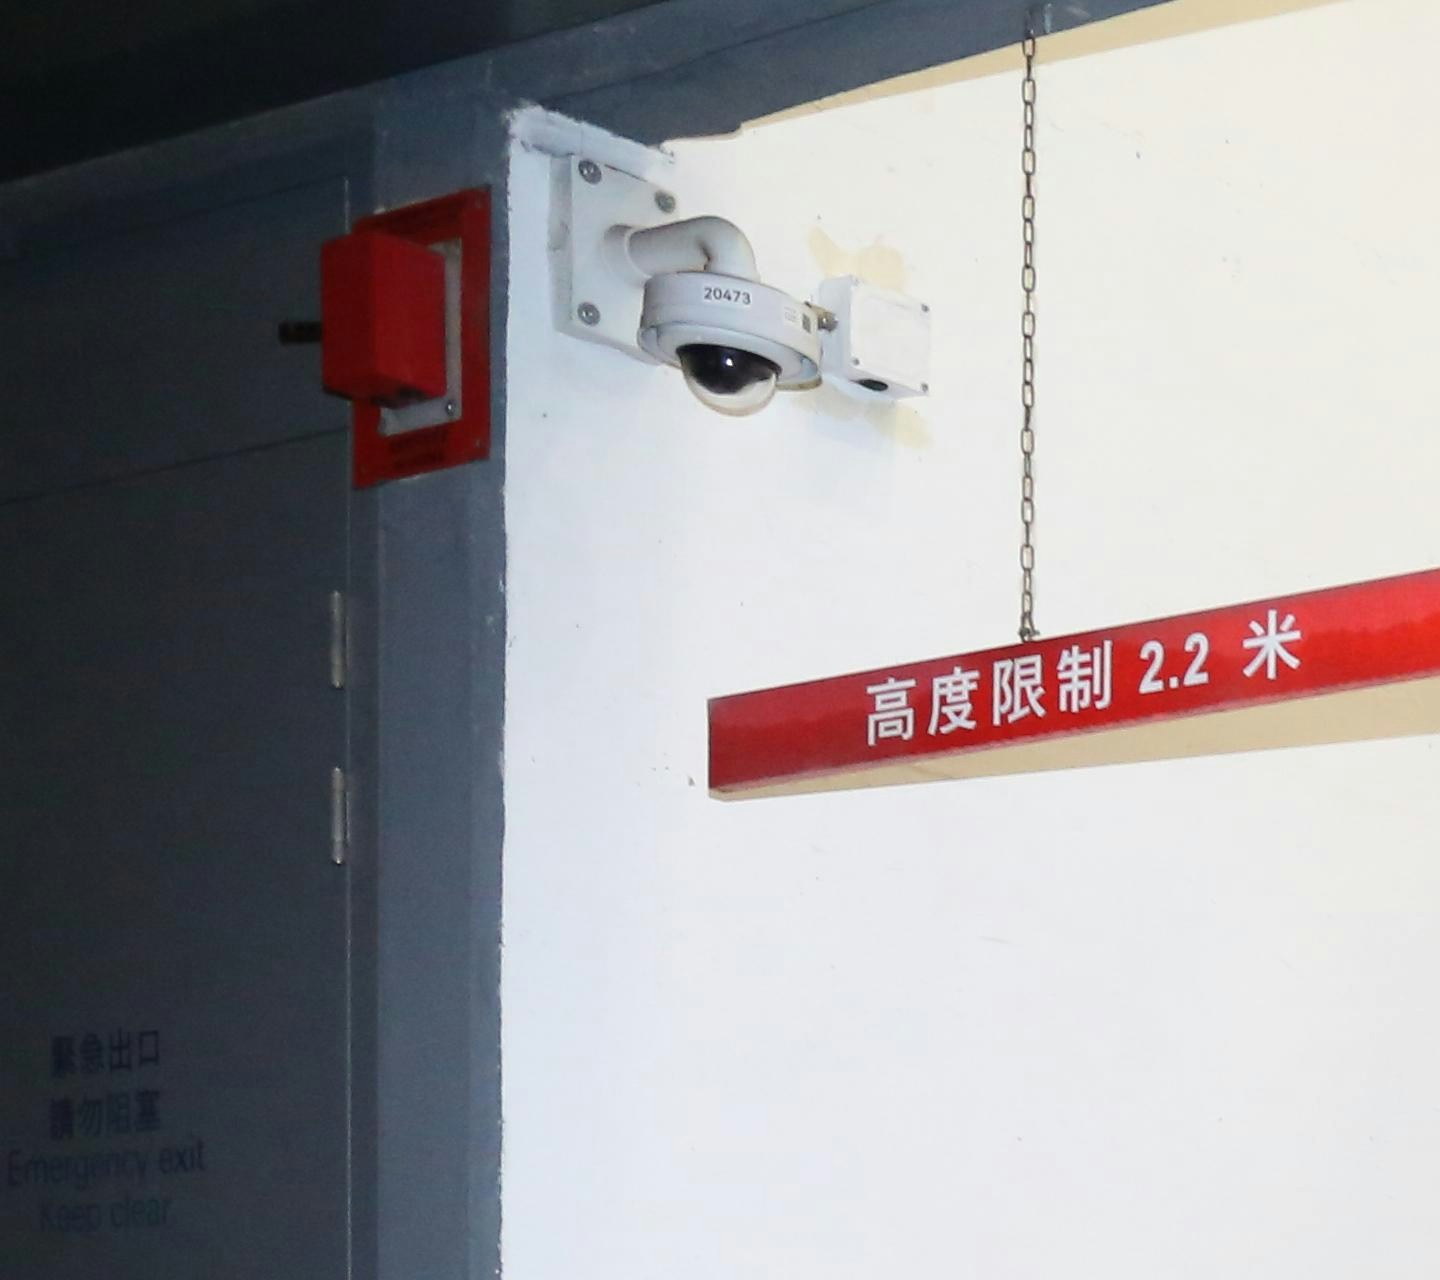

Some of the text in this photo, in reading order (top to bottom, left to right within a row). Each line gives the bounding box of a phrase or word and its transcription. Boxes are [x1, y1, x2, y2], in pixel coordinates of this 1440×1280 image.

[703, 286, 752, 305] 20473
[866, 608, 1302, 747] 高度限制 2.2 米
[158, 1134, 206, 1175] exit
[109, 1194, 173, 1229] clear
